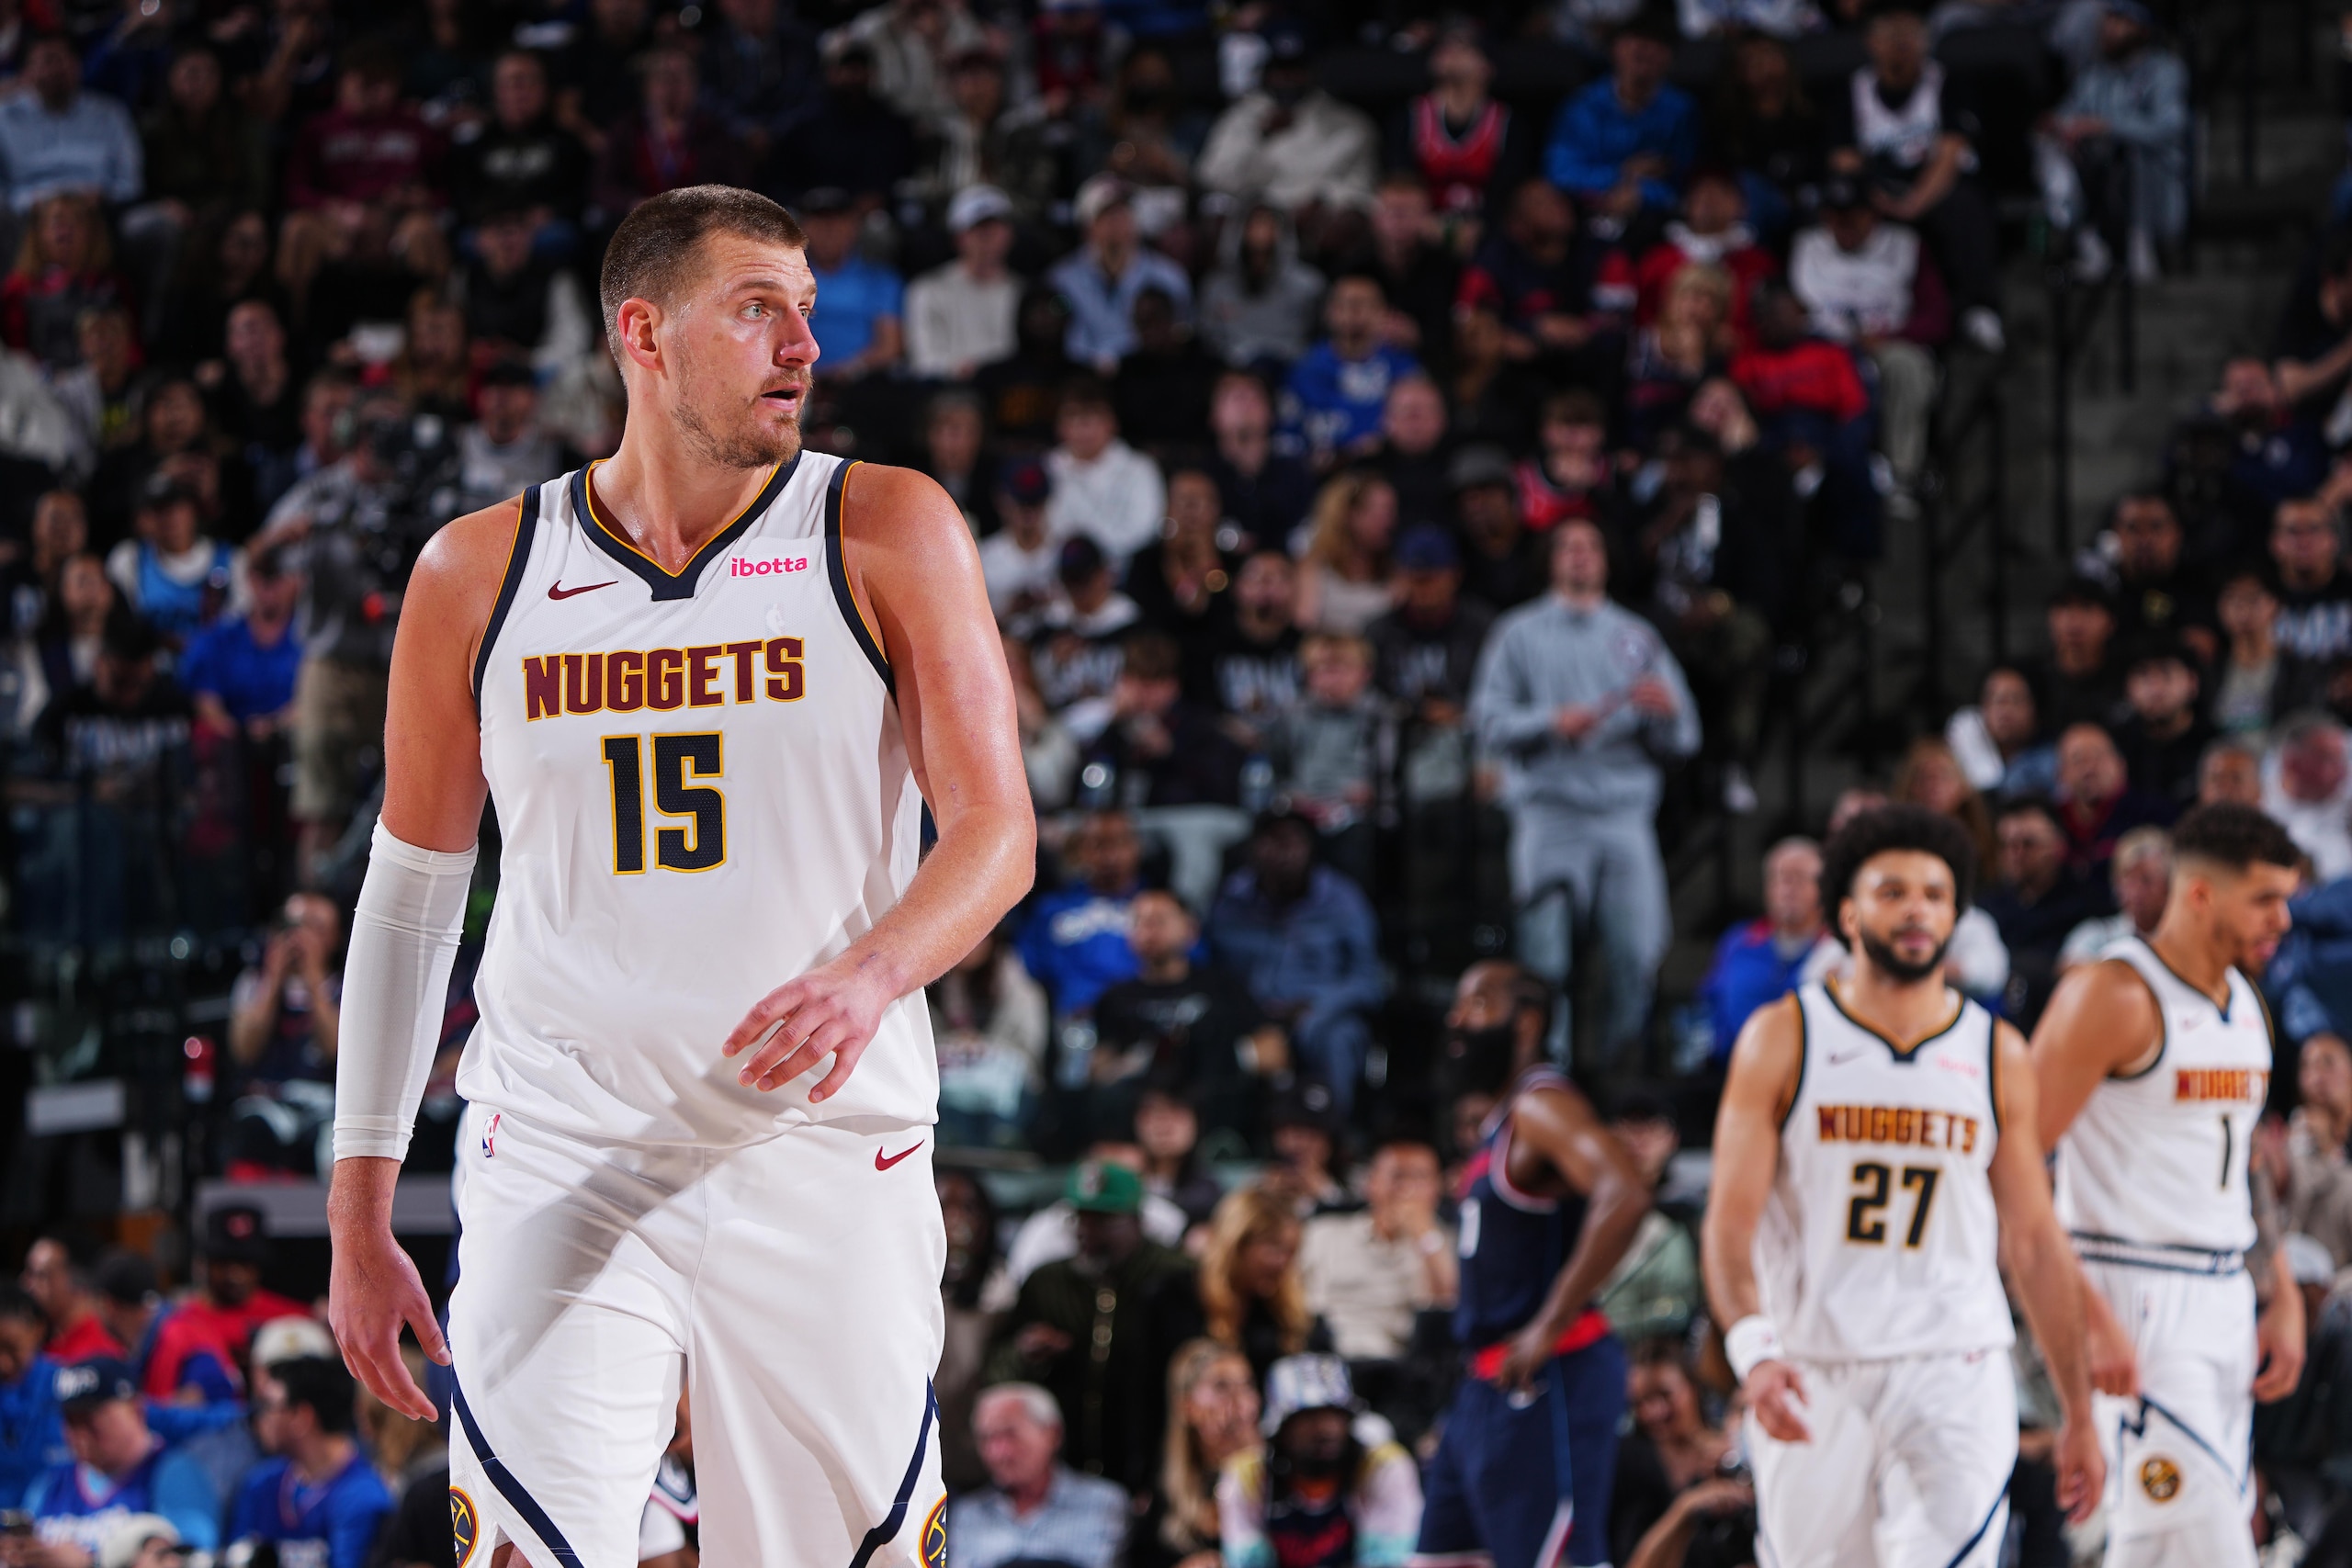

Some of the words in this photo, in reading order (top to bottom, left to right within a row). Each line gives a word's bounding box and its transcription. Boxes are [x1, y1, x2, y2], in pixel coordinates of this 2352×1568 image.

[731, 557, 808, 577] ibotta
[522, 636, 806, 722] NUGGETS
[600, 730, 727, 875] 15
[2176, 1068, 2272, 1100] NUGGET
[1816, 1105, 1978, 1154] NUGGETS
[2219, 1112, 2233, 1190] 1
[1846, 1161, 1943, 1249] 27
